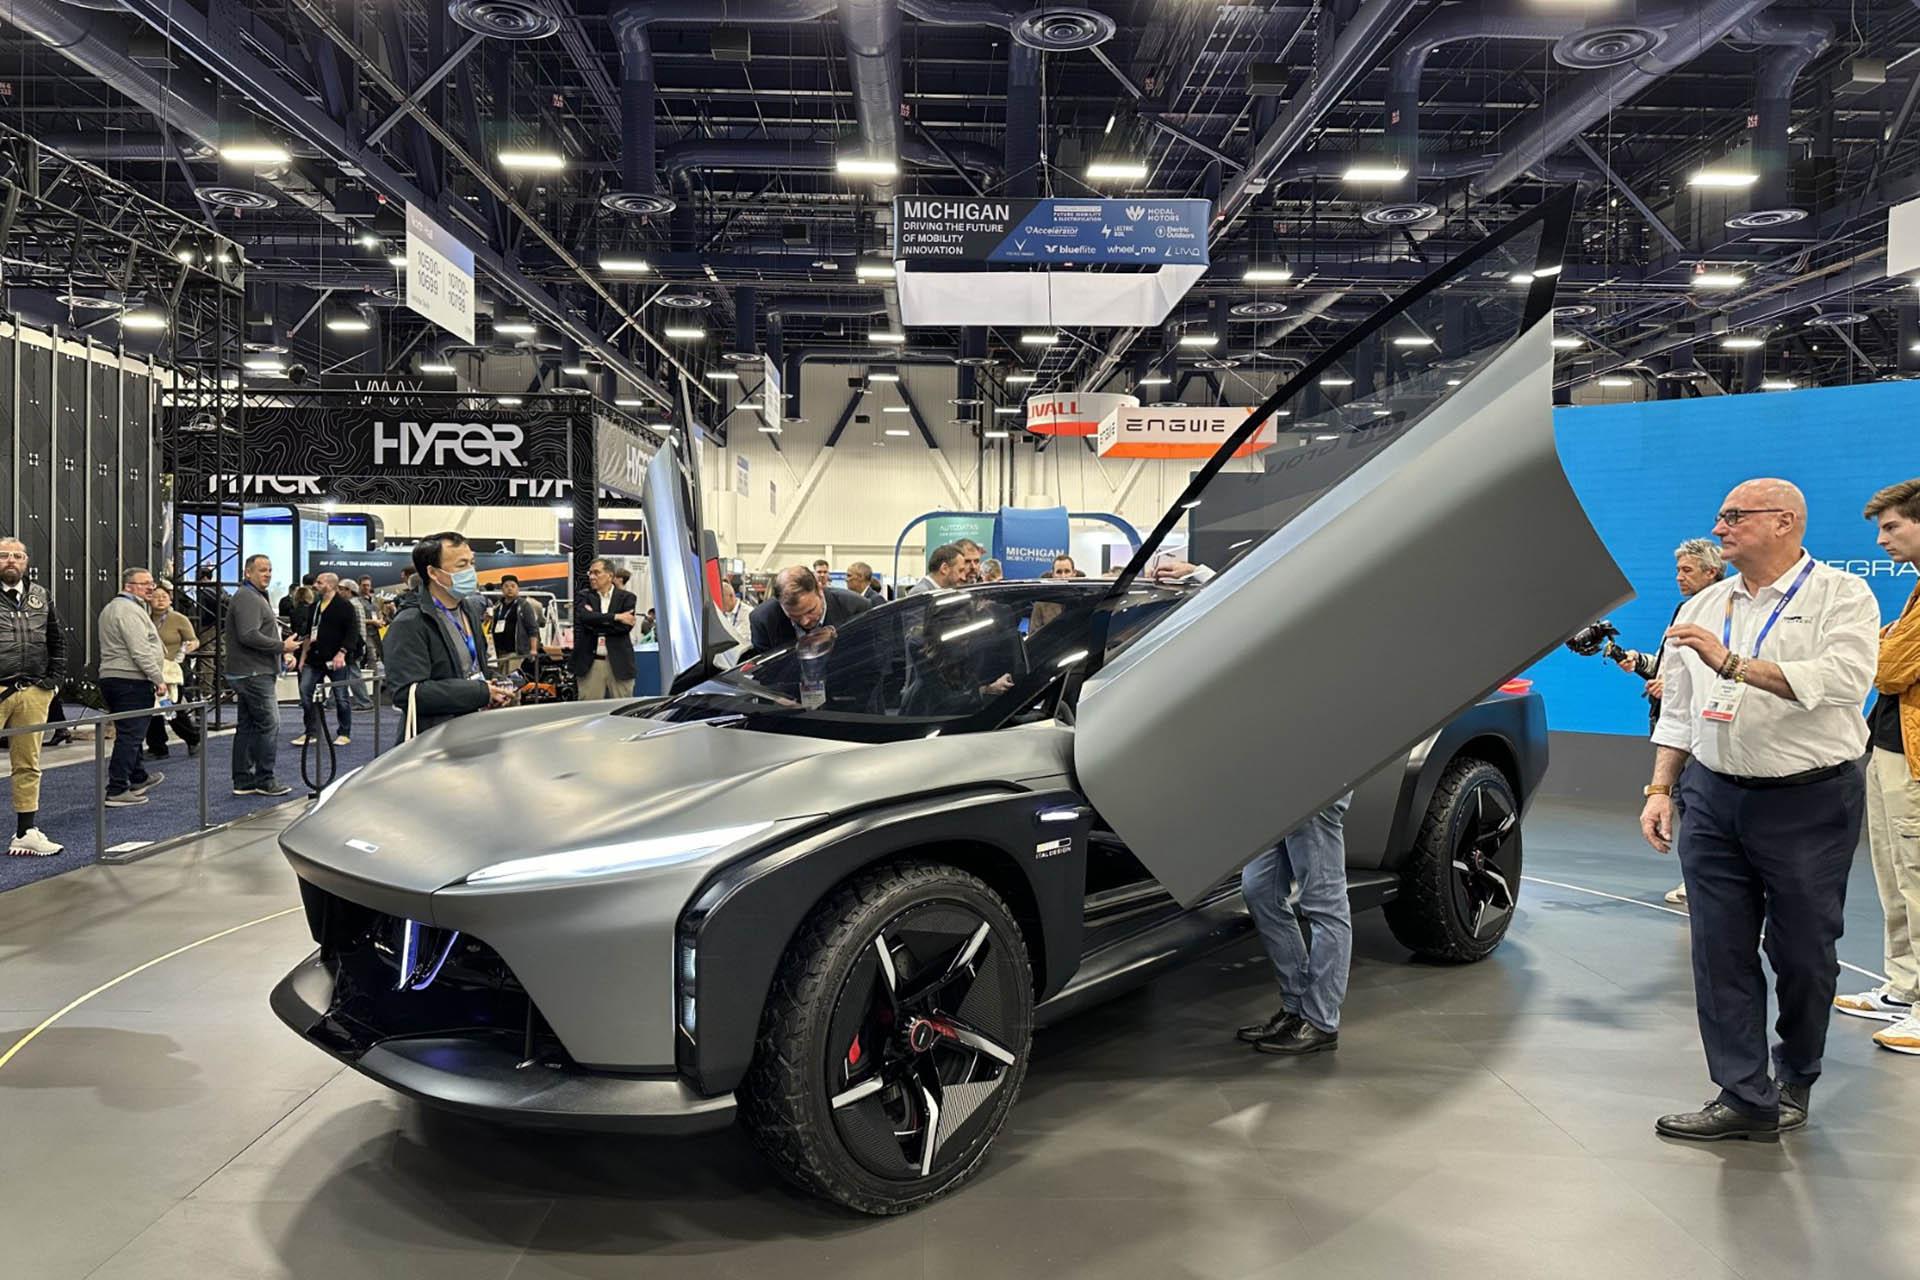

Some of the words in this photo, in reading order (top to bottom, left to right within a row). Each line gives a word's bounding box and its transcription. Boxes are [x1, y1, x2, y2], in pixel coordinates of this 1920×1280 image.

[903, 201, 1010, 221] MICHIGAN
[903, 222, 943, 231] DRIVING
[945, 223, 964, 232] THE
[966, 223, 1004, 233] FUTURE
[1032, 226, 1079, 235] Accelerator
[903, 233, 916, 243] OF
[918, 234, 964, 243] MOBILITY
[902, 246, 964, 255] INNOVATION
[374, 422, 524, 467] HYPER
[1006, 546, 1065, 558] MICHIGAN
[1816, 560, 1920, 577] EGRA
